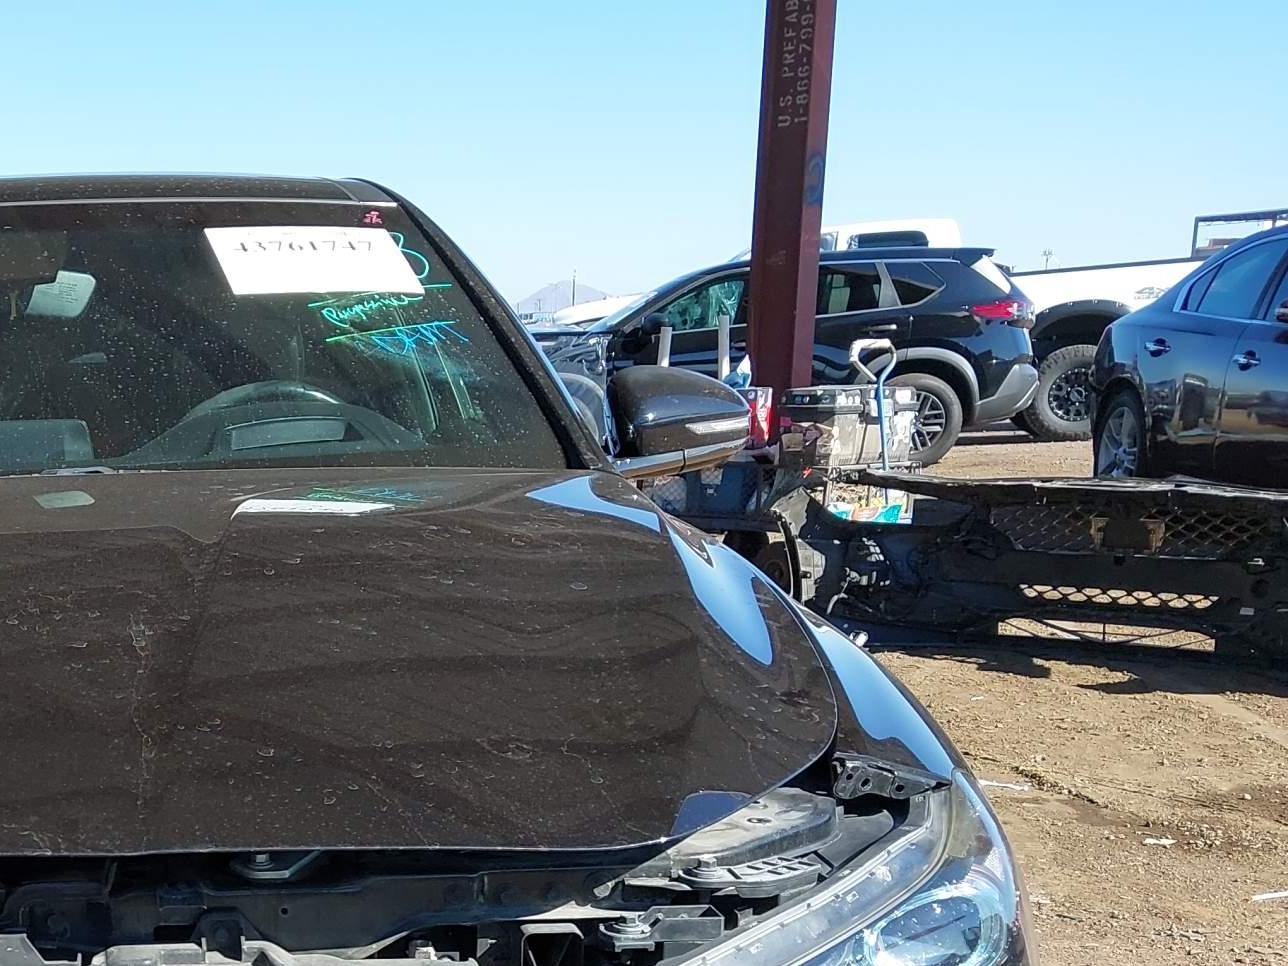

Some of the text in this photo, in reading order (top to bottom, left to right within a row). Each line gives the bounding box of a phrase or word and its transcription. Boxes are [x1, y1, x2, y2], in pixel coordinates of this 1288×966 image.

[777, 0, 799, 127] U.S. PREFAB
[794, 0, 814, 123] 1-866-799-
